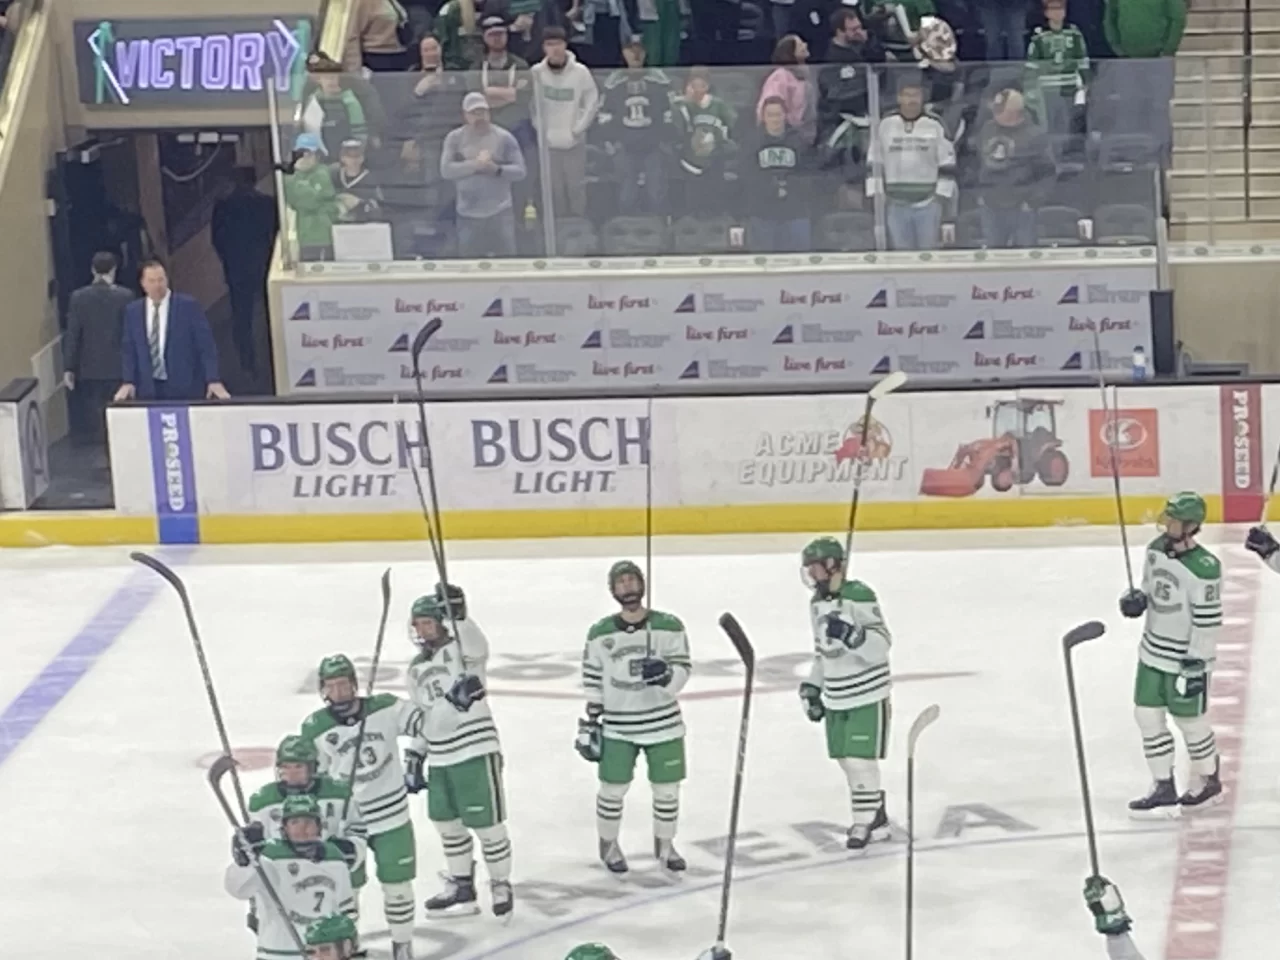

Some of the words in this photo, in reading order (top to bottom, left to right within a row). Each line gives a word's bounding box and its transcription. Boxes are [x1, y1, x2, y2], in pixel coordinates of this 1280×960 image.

[116, 31, 299, 91] VICTORY
[588, 294, 614, 309] live
[619, 295, 650, 311] first
[780, 290, 806, 305] live
[811, 290, 841, 306] first
[972, 285, 998, 300] live
[1002, 286, 1034, 303] first
[395, 298, 423, 313] live
[427, 299, 459, 315] first
[686, 325, 712, 340] live
[717, 326, 748, 342] first
[877, 320, 904, 336] live
[908, 321, 939, 338] first
[1068, 316, 1095, 331] live
[1100, 317, 1131, 333] first
[301, 333, 329, 348] live
[333, 334, 364, 350] first
[494, 329, 521, 344] live
[525, 331, 556, 346] first
[591, 360, 618, 376] live
[624, 361, 655, 377] first
[784, 355, 811, 371] live
[815, 356, 845, 372] first
[974, 352, 1000, 366] live
[1005, 353, 1036, 369] first
[431, 365, 462, 380] first
[249, 420, 430, 471] BUSCH
[471, 416, 651, 468] BUSCH
[755, 430, 840, 457] ACME
[1233, 390, 1251, 489] PROSEED
[161, 413, 186, 511] PROSEED
[293, 474, 395, 497] LIGHT
[513, 470, 616, 494] LIGHT
[424, 680, 445, 701] 15
[313, 891, 325, 913] 7
